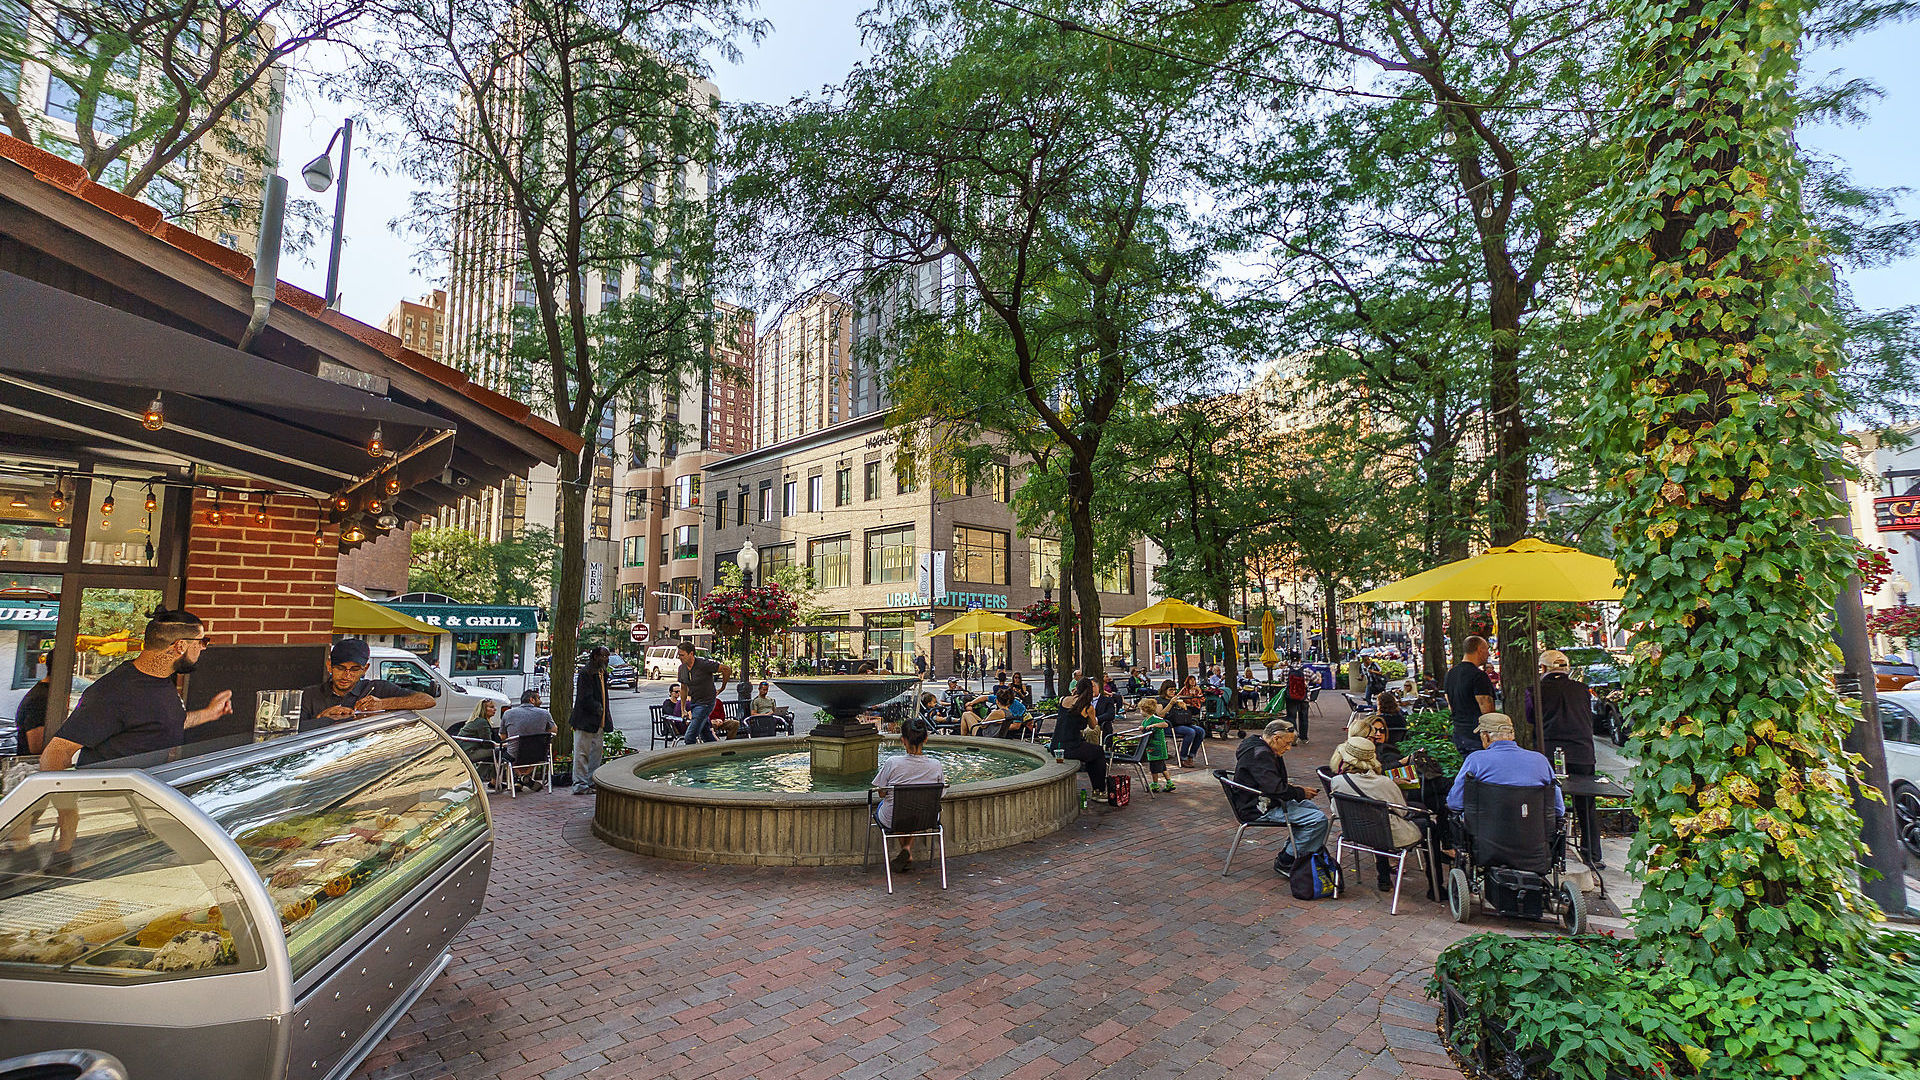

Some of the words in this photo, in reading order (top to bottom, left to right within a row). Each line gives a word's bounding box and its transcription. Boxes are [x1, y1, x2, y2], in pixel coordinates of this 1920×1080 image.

[589, 562, 598, 601] MERLO
[0, 607, 58, 621] UBL
[415, 616, 441, 626] AR
[446, 616, 461, 626] &
[465, 616, 522, 627] GRILL
[479, 638, 498, 646] OPEN
